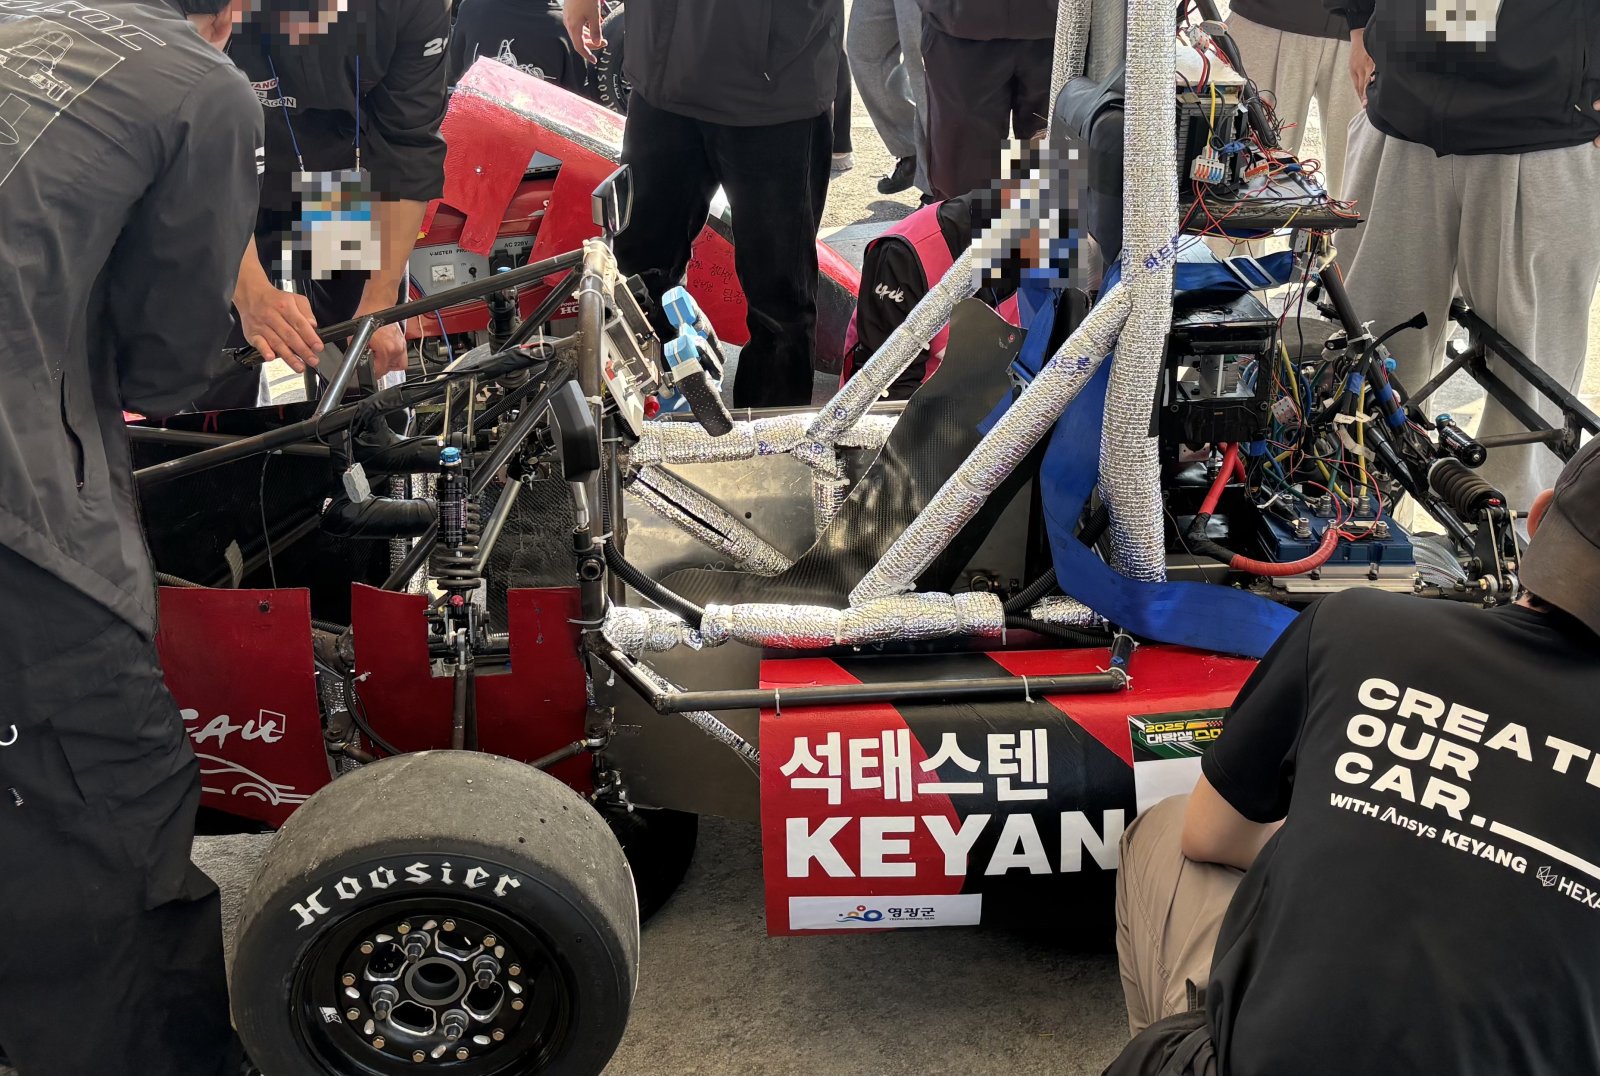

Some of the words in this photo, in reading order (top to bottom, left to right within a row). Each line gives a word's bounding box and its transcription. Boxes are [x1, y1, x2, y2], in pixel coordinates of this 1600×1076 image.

[1145, 722, 1186, 734] 2025
[1146, 730, 1193, 744] 대학생
[1346, 714, 1480, 782] OUR
[779, 728, 1049, 804] 석태스텐
[1330, 792, 1380, 818] WITH
[1380, 807, 1438, 838] Ansys
[1441, 829, 1528, 874] KEYANG
[289, 860, 522, 931] Hoosier
[887, 907, 936, 918] 영광군
